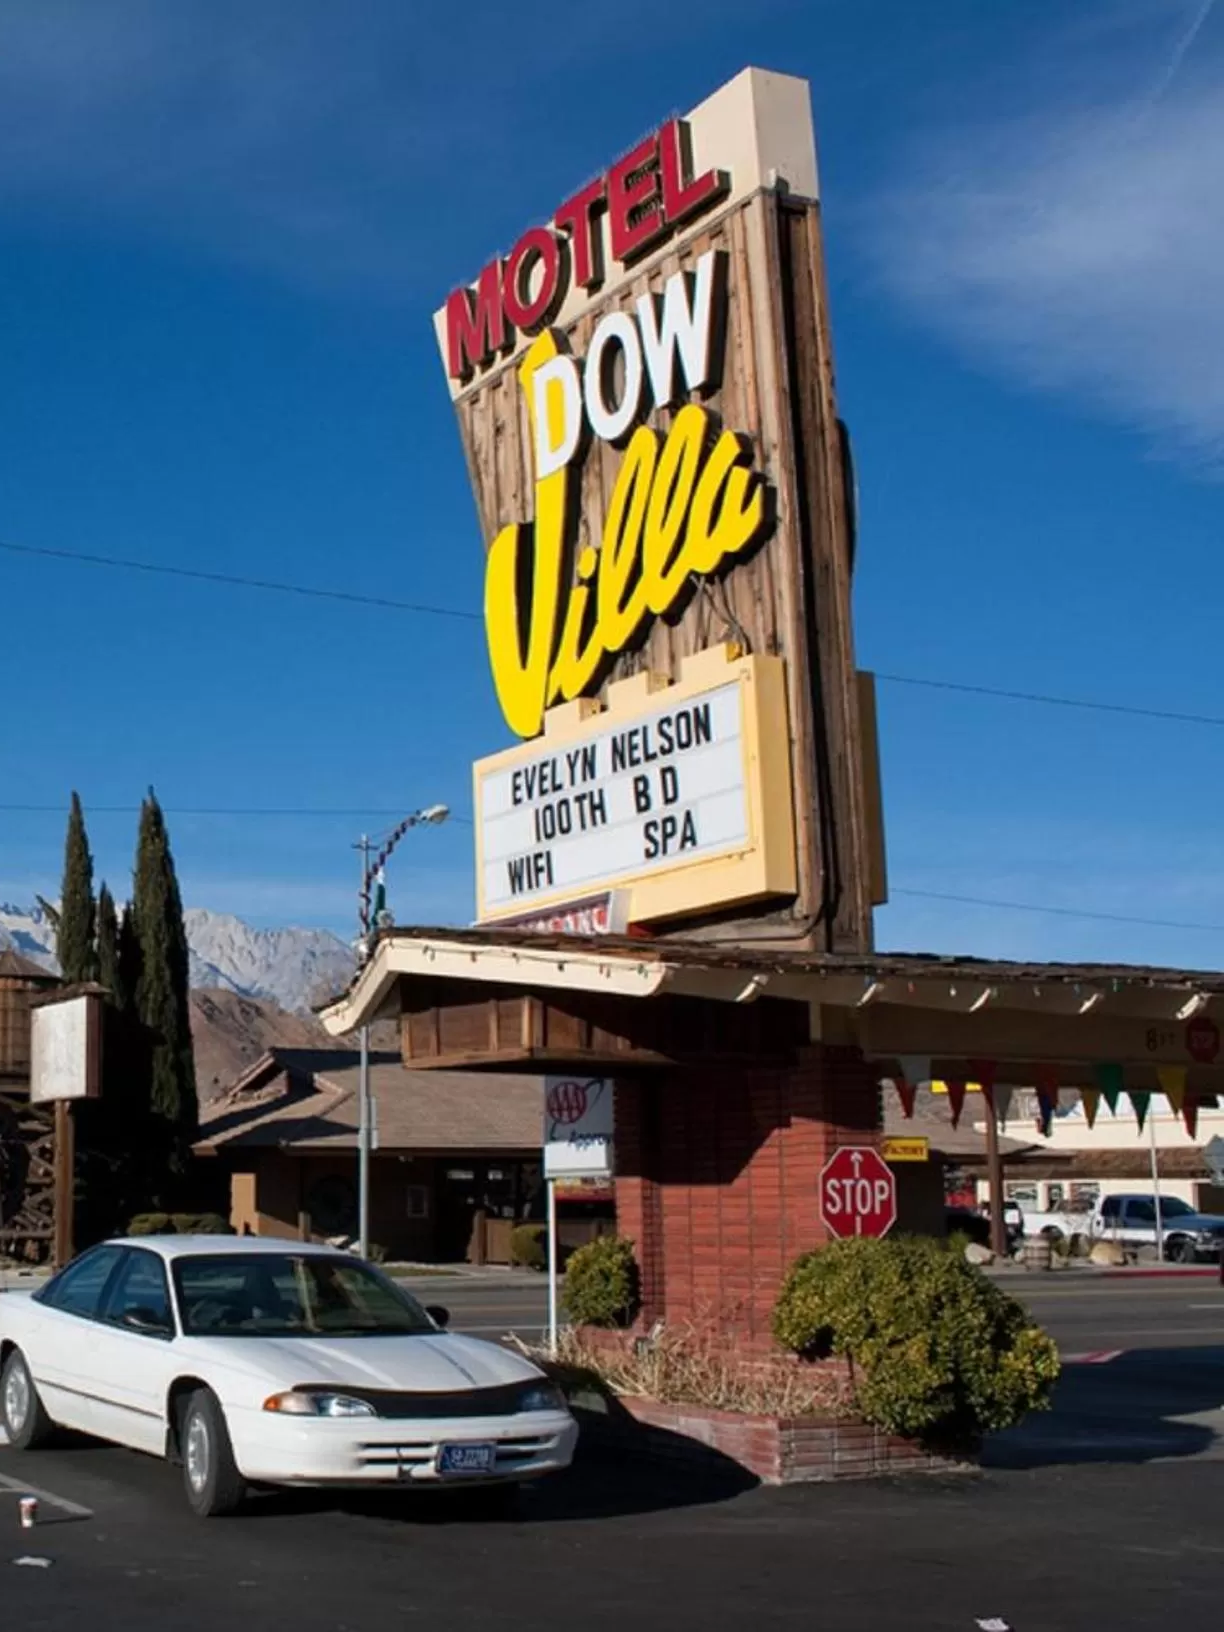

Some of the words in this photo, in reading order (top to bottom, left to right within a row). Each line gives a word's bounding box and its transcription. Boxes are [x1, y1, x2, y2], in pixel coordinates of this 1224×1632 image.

[445, 118, 725, 380] MOTEL
[532, 249, 721, 480] DOW
[484, 327, 764, 738] Villa
[511, 744, 597, 807] EVELYN
[611, 703, 712, 773] NELSON
[534, 788, 607, 843] 100TH
[632, 774, 652, 814] B
[659, 765, 680, 807] D
[507, 850, 554, 895] WIFI
[643, 809, 698, 860] SPA
[548, 1083, 586, 1123] AAA
[825, 1178, 890, 1215] STOP
